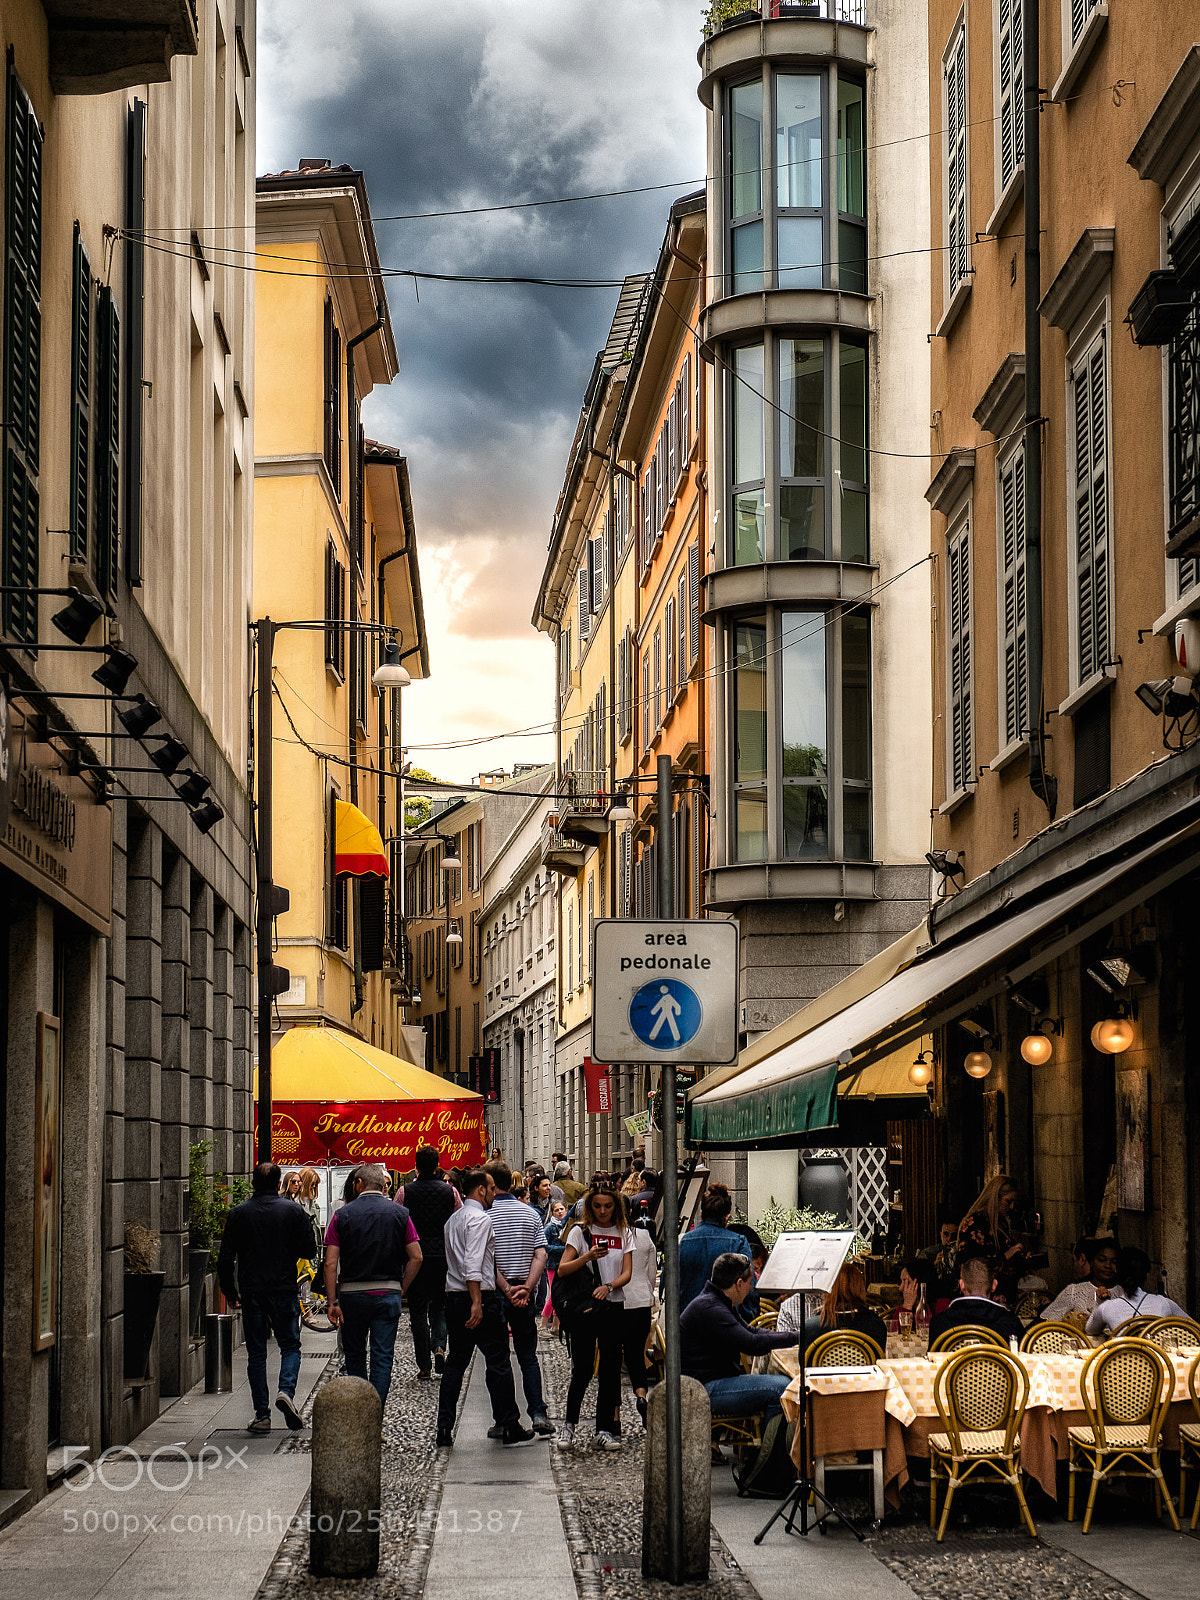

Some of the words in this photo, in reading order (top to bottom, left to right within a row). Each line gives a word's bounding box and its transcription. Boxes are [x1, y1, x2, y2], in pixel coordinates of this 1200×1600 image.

[644, 932, 688, 946] area
[620, 953, 711, 972] pedonale
[313, 1112, 418, 1134] Trattoria
[418, 1112, 436, 1132] il
[437, 1110, 479, 1132] Cestino
[346, 1138, 414, 1157] Cucina
[416, 1135, 431, 1153] &
[436, 1134, 472, 1161] Pizza
